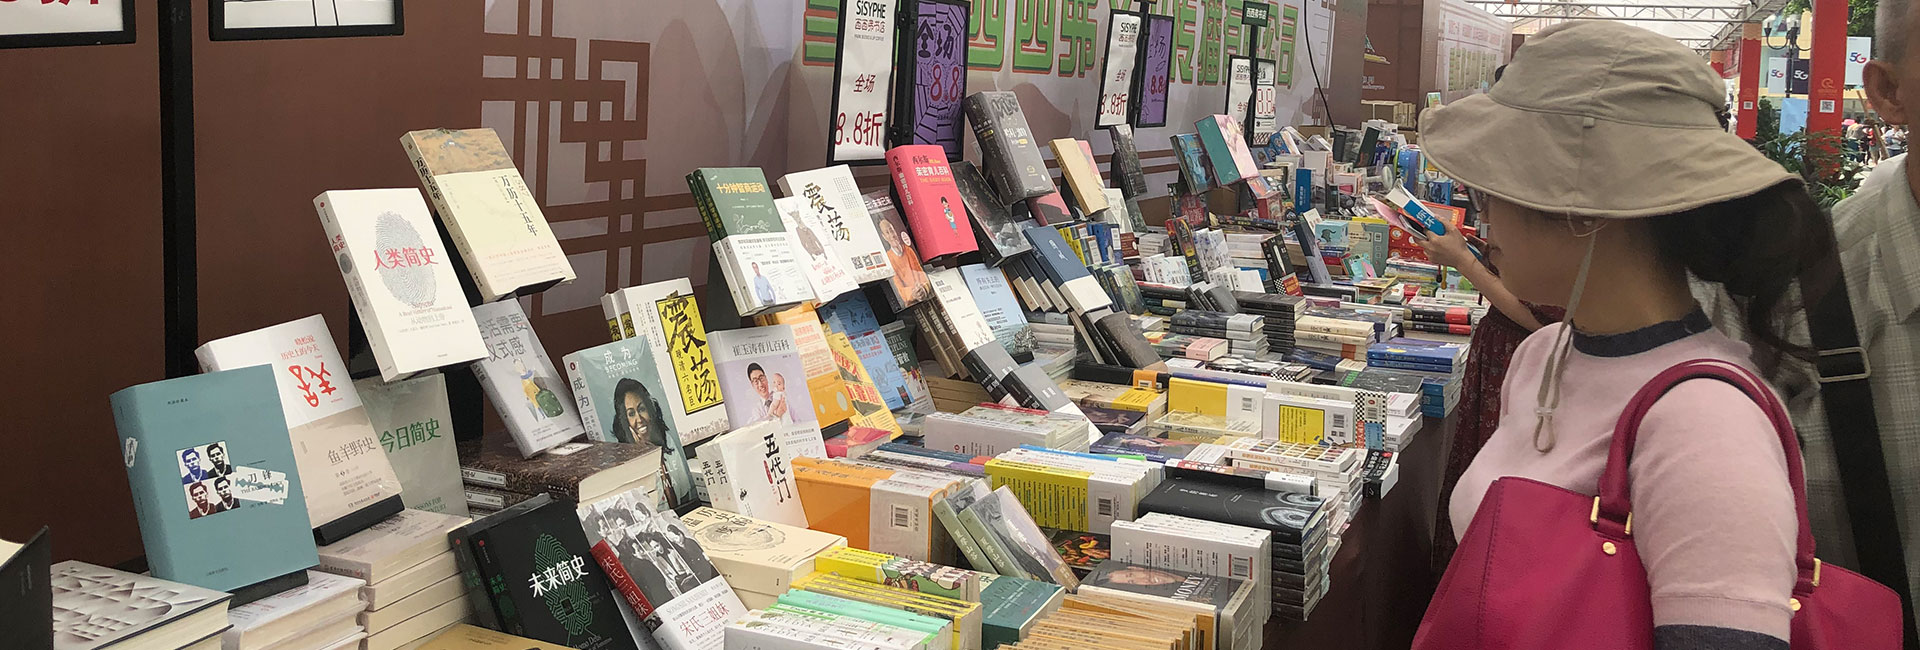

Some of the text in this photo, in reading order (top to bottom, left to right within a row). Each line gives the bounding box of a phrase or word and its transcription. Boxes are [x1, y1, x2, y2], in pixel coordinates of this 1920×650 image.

[1849, 52, 1867, 64] 5G
[853, 73, 876, 93] 全场
[1771, 69, 1784, 79] 5G
[1793, 70, 1808, 80] 5G
[834, 110, 883, 147] 8.8折
[415, 157, 441, 201] 万历十五年
[500, 175, 538, 236] 万历十五年
[373, 245, 439, 271] 人类简史
[732, 339, 790, 357] 崔玉涛育儿百科
[605, 359, 638, 374] BECOMING
[573, 377, 591, 409] 成为
[379, 417, 443, 453] 今日简史
[328, 436, 377, 466] 鱼羊野史
[702, 461, 716, 486] 五代门
[715, 459, 728, 485] 五代门
[763, 433, 792, 503] 五代门
[528, 555, 589, 599] 未来简史
[600, 555, 650, 617] 宋氏三姐妹
[680, 601, 730, 638] 宋氏三姐妹
